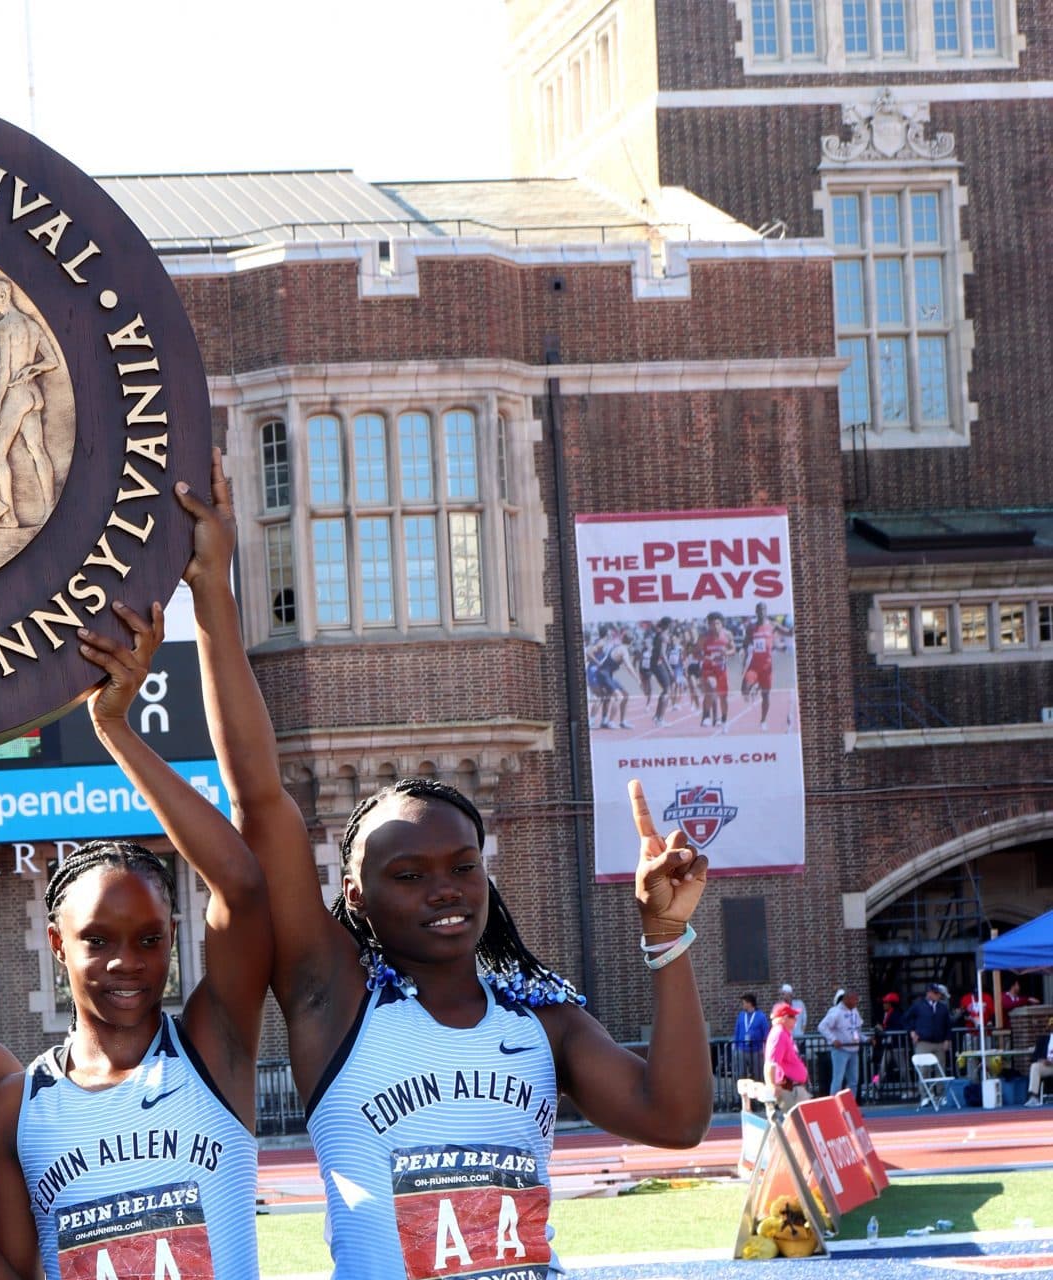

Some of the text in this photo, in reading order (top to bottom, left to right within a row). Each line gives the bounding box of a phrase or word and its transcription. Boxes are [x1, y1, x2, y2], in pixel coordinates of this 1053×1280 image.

[587, 537, 782, 572] THE PENN
[592, 570, 784, 605] RELAYS
[618, 752, 778, 769] PENNRELAYS.COM
[361, 1072, 442, 1135] EDWIN
[453, 1070, 533, 1112] ALLEN
[35, 1129, 223, 1215] EDWIN ALLEN HS
[393, 1151, 537, 1173] PENN RELAYS
[414, 1174, 490, 1187] ON-RUNNING.COM
[58, 1187, 198, 1232] PENN RELAYS
[75, 1219, 144, 1241] ON-RUNNING.COM
